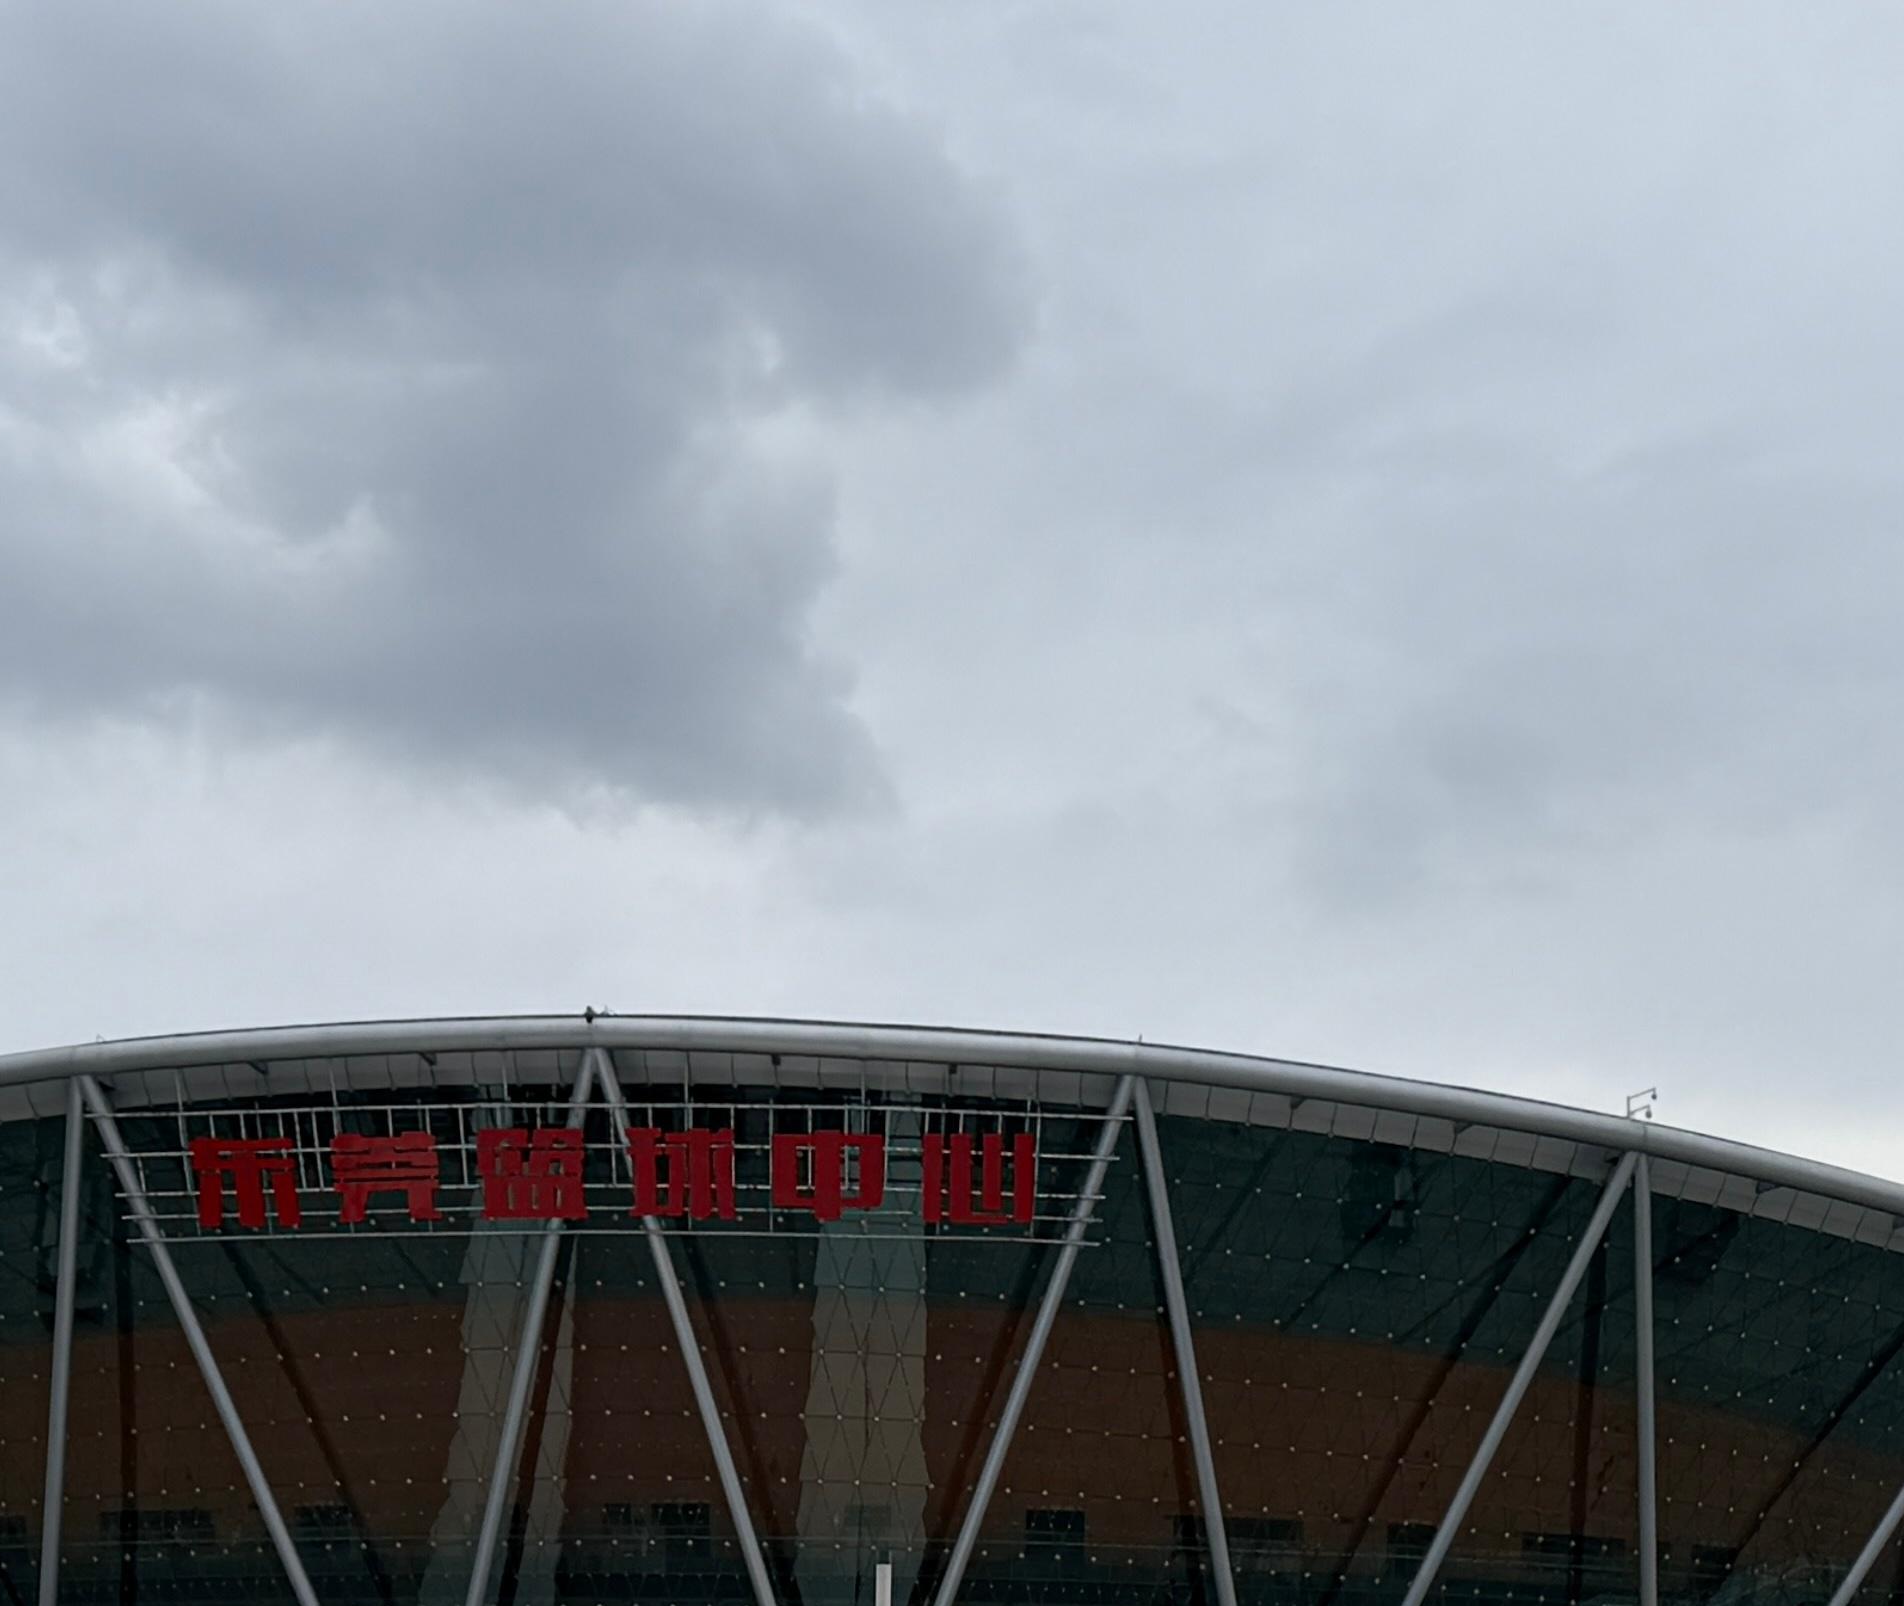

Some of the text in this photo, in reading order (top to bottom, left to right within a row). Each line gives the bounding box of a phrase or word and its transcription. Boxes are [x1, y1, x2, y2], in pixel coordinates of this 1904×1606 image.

[187, 1126, 1035, 1229] 东莞篮球中心
